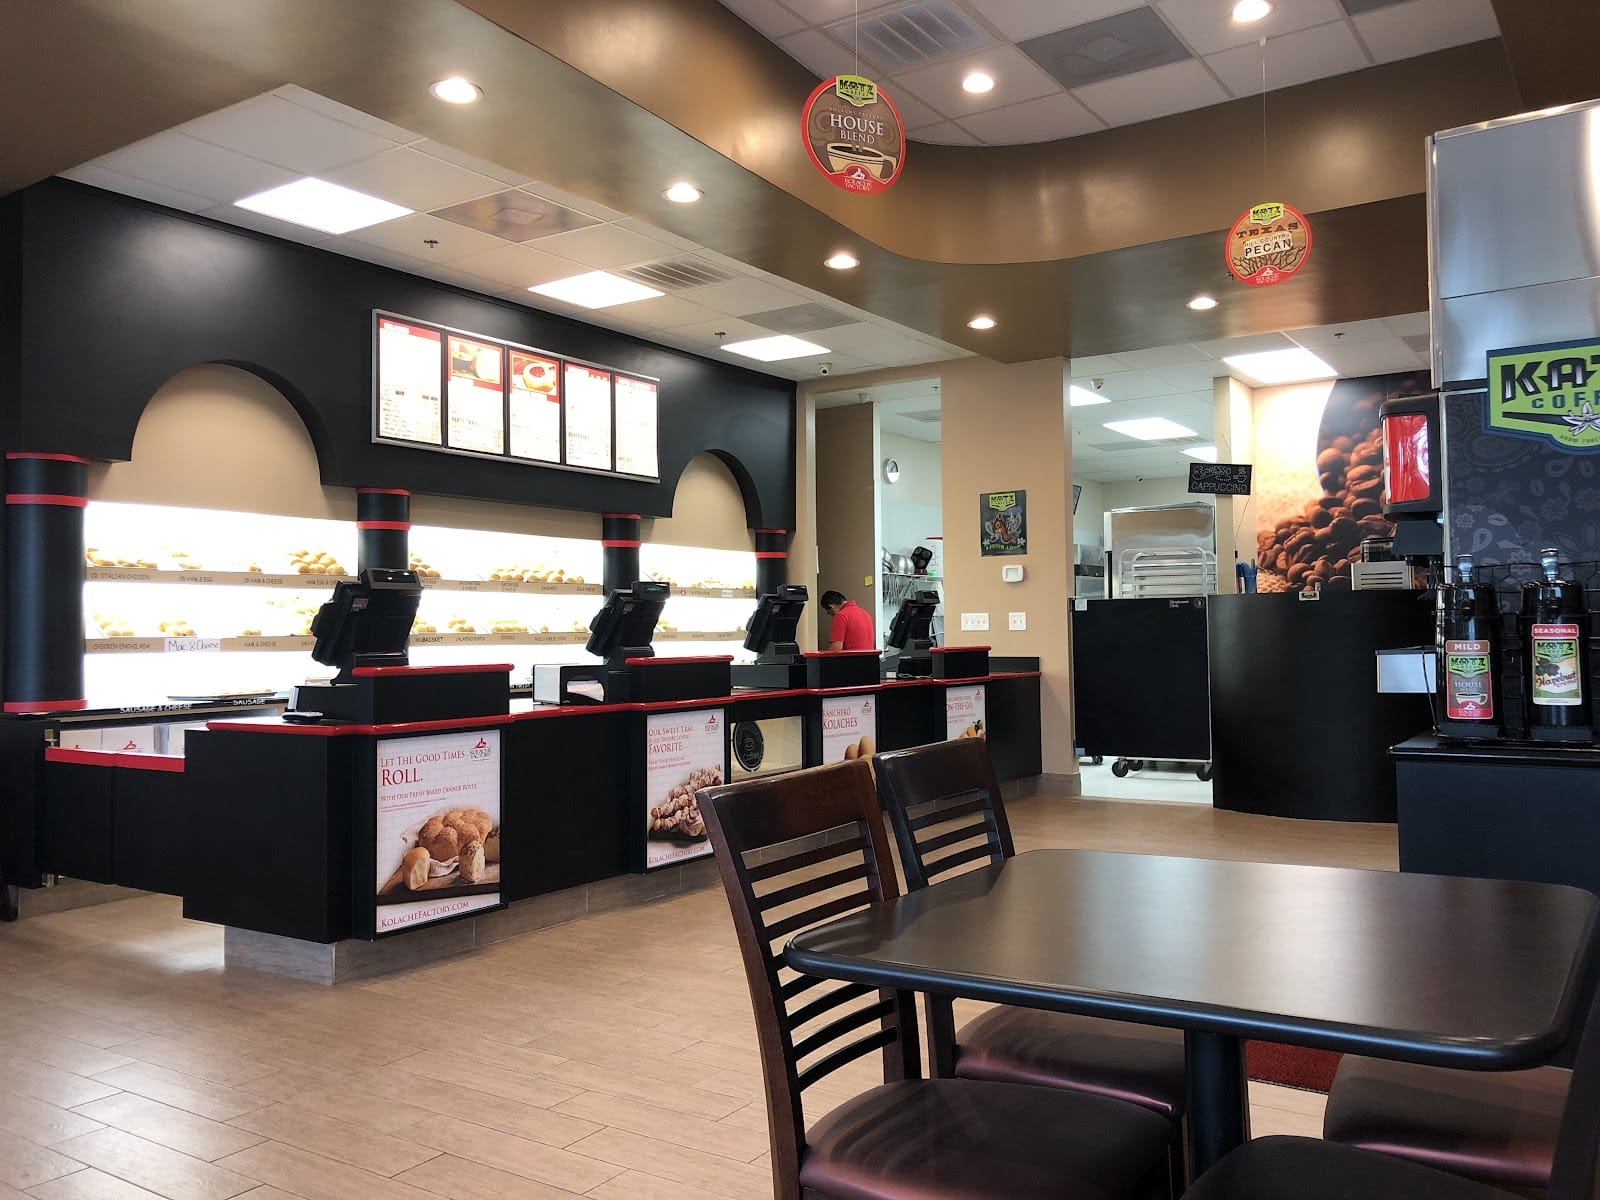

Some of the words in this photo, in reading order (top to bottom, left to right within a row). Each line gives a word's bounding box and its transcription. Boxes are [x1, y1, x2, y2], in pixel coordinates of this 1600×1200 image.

[839, 79, 874, 96] KATZ
[830, 113, 884, 136] HOUSE
[840, 129, 875, 145] BLEND
[1252, 205, 1281, 216] KATZ
[1236, 222, 1299, 239] TEXAS
[1259, 233, 1291, 244] COUNTRY
[1245, 239, 1292, 257] PECAN
[1191, 481, 1248, 493] CAPPUCCINO
[168, 640, 187, 652] Mac
[196, 639, 219, 652] Cheese
[1454, 643, 1481, 651] MILD
[1537, 642, 1574, 651] KATZ
[1450, 657, 1485, 667] KATZ
[1536, 671, 1577, 687] Hazelnut
[120, 705, 156, 713] SAUSAGE
[164, 703, 192, 711] CHEESE
[648, 729, 661, 737] OUR
[380, 758, 394, 768] LET
[397, 756, 413, 766] THE
[416, 753, 440, 763] GOOD
[442, 751, 465, 760] TIMES
[382, 768, 423, 786] ROLL.
[443, 785, 462, 793] DINNER
